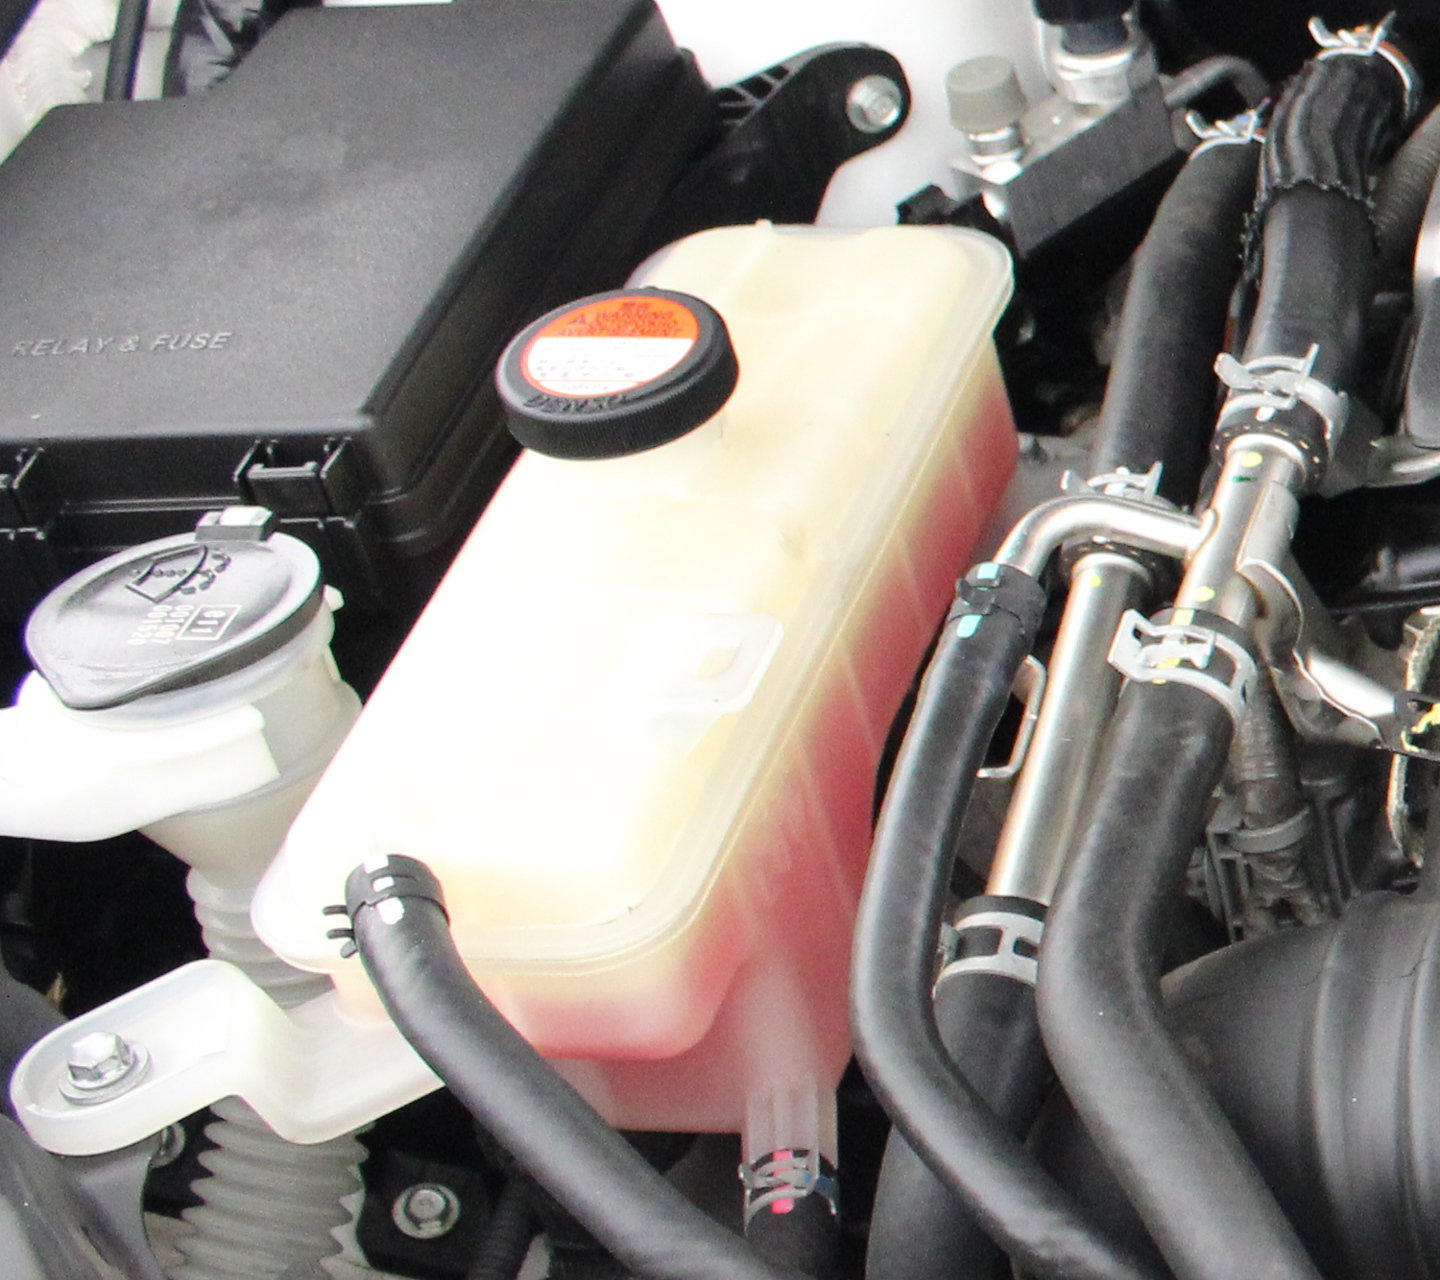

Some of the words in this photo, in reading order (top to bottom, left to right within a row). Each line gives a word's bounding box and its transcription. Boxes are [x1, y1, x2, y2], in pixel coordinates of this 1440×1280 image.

[12, 337, 114, 358] RELAY
[118, 335, 140, 353] &
[150, 331, 233, 351] FUSE
[149, 604, 195, 645] 001007
[190, 609, 227, 633] e11
